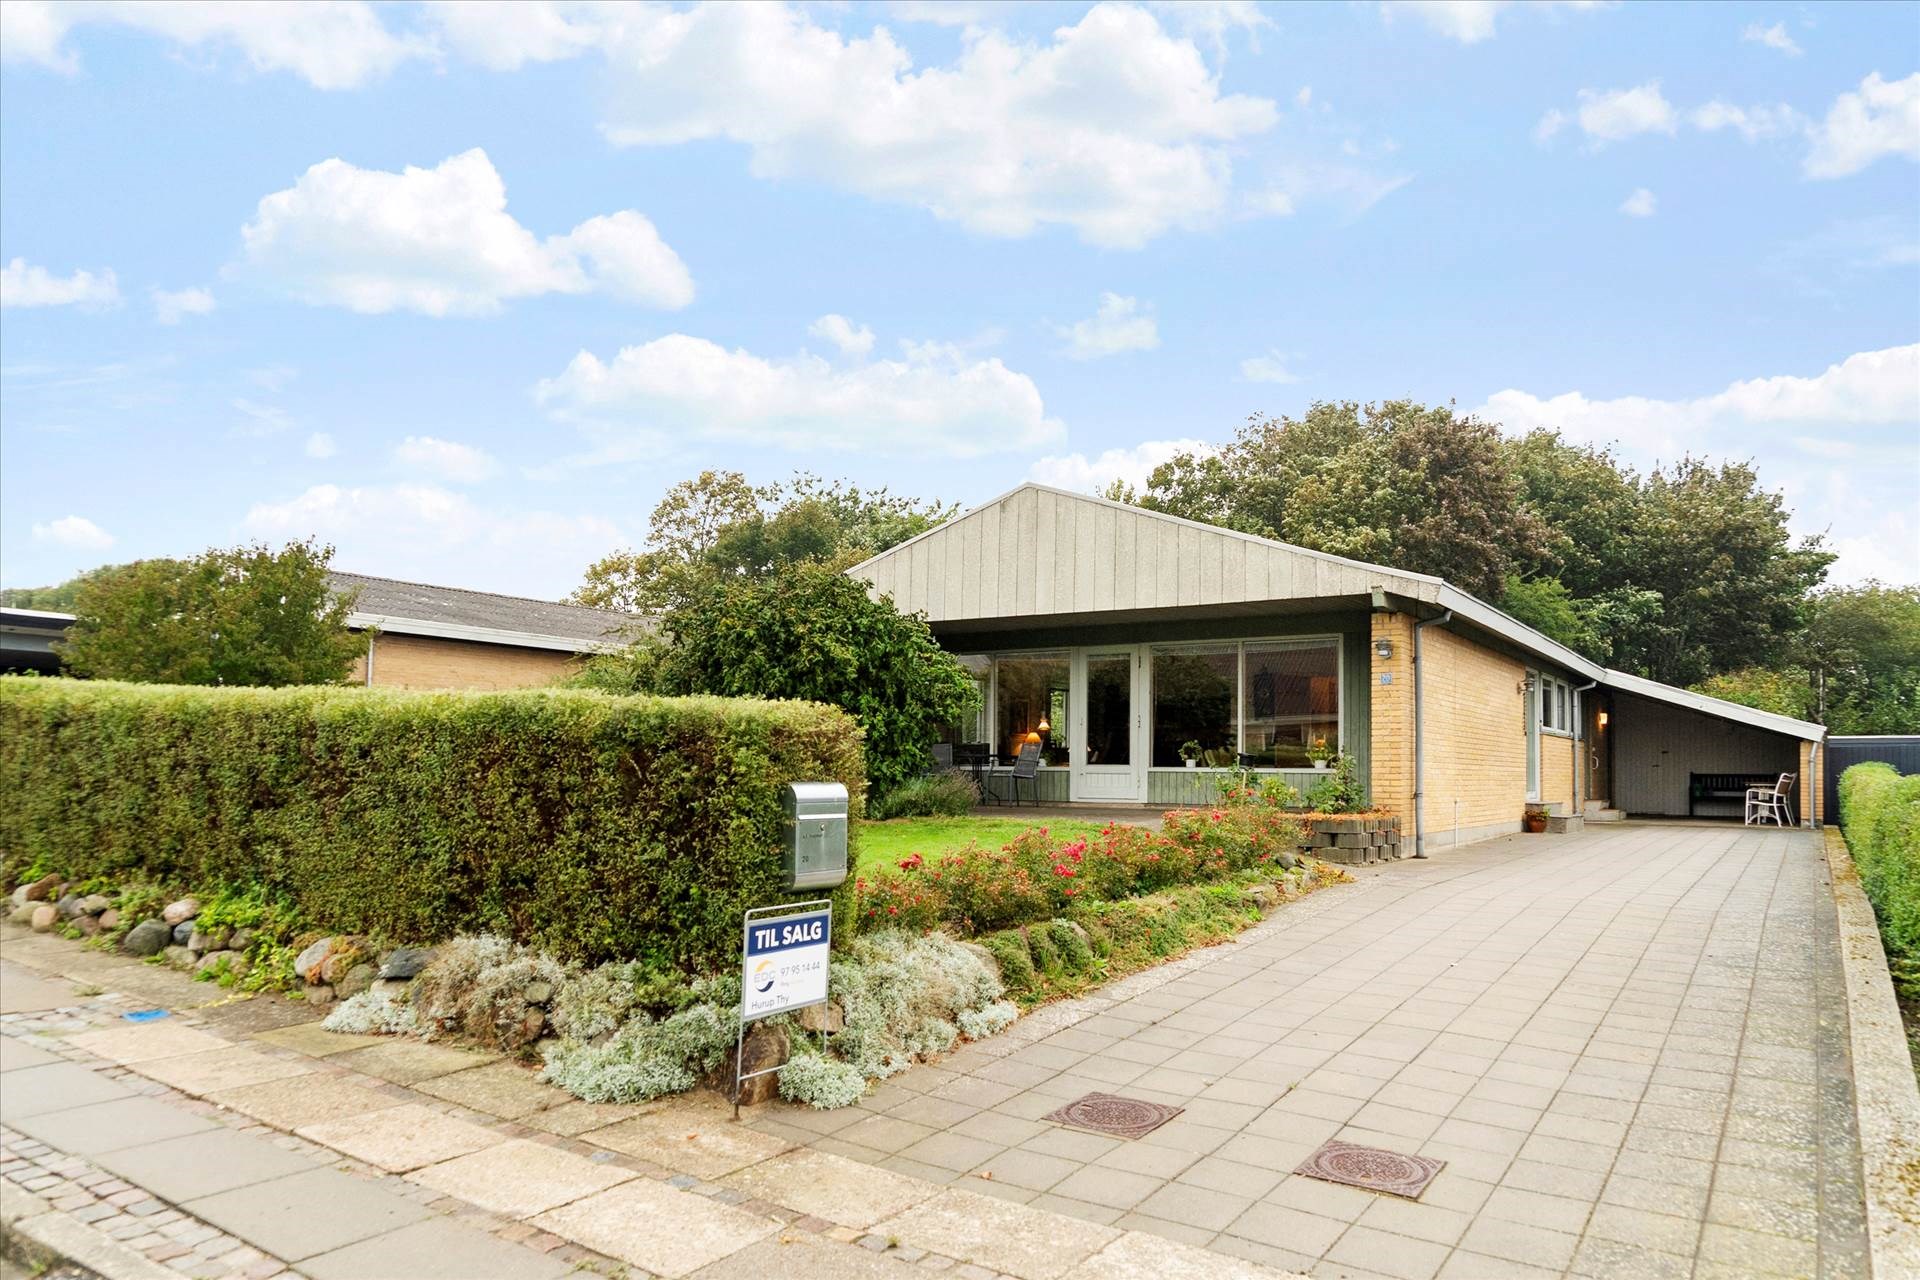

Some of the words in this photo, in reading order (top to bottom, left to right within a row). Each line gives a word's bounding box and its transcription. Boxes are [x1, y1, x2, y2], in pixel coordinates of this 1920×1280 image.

[755, 928, 779, 950] TIL
[782, 921, 822, 945] SALG
[751, 1000, 774, 1010] Hurup
[776, 994, 789, 1005] Thy
